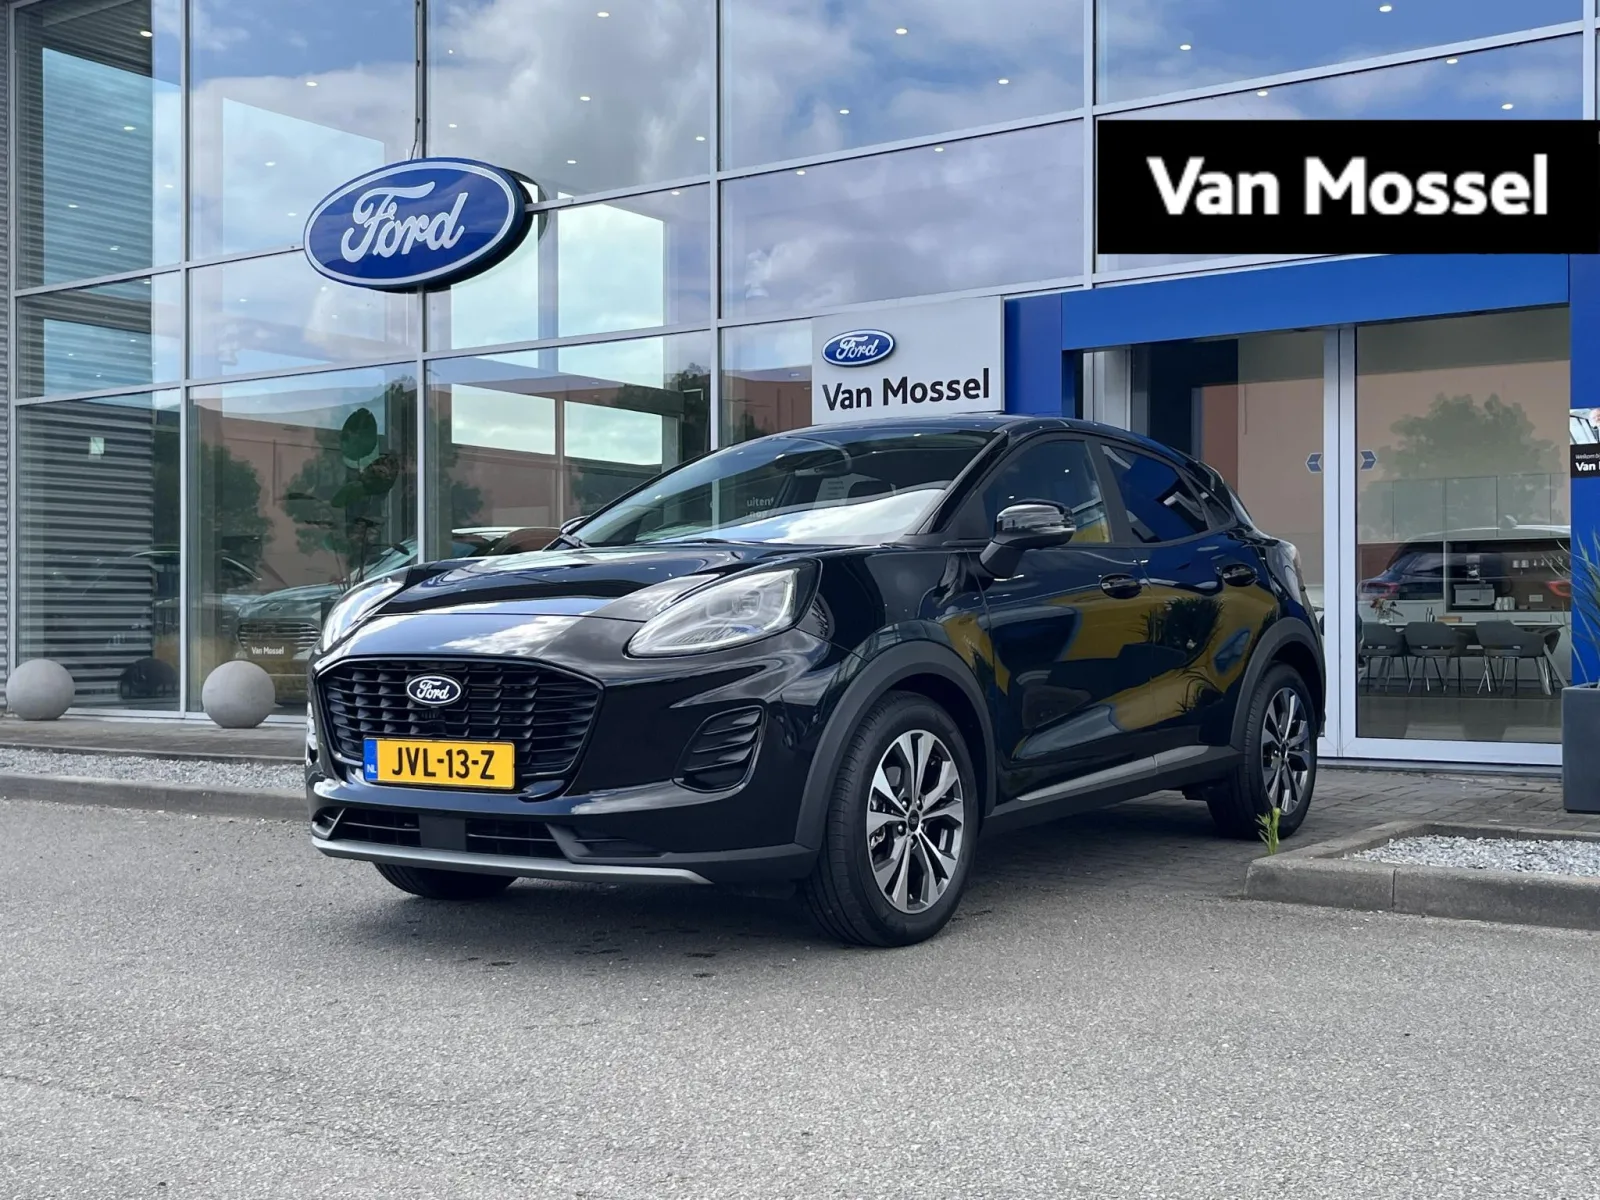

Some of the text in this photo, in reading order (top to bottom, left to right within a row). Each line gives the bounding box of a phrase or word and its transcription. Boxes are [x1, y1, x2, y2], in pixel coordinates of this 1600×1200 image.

[340, 181, 469, 263] Ford
[835, 335, 880, 360] Ford
[822, 367, 990, 411] Van Mossel
[1575, 462, 1596, 471] Van
[251, 645, 285, 655] Van Mossel
[416, 679, 451, 700] Ford
[366, 763, 377, 774] NL
[391, 746, 495, 780] JVL-13-Z
